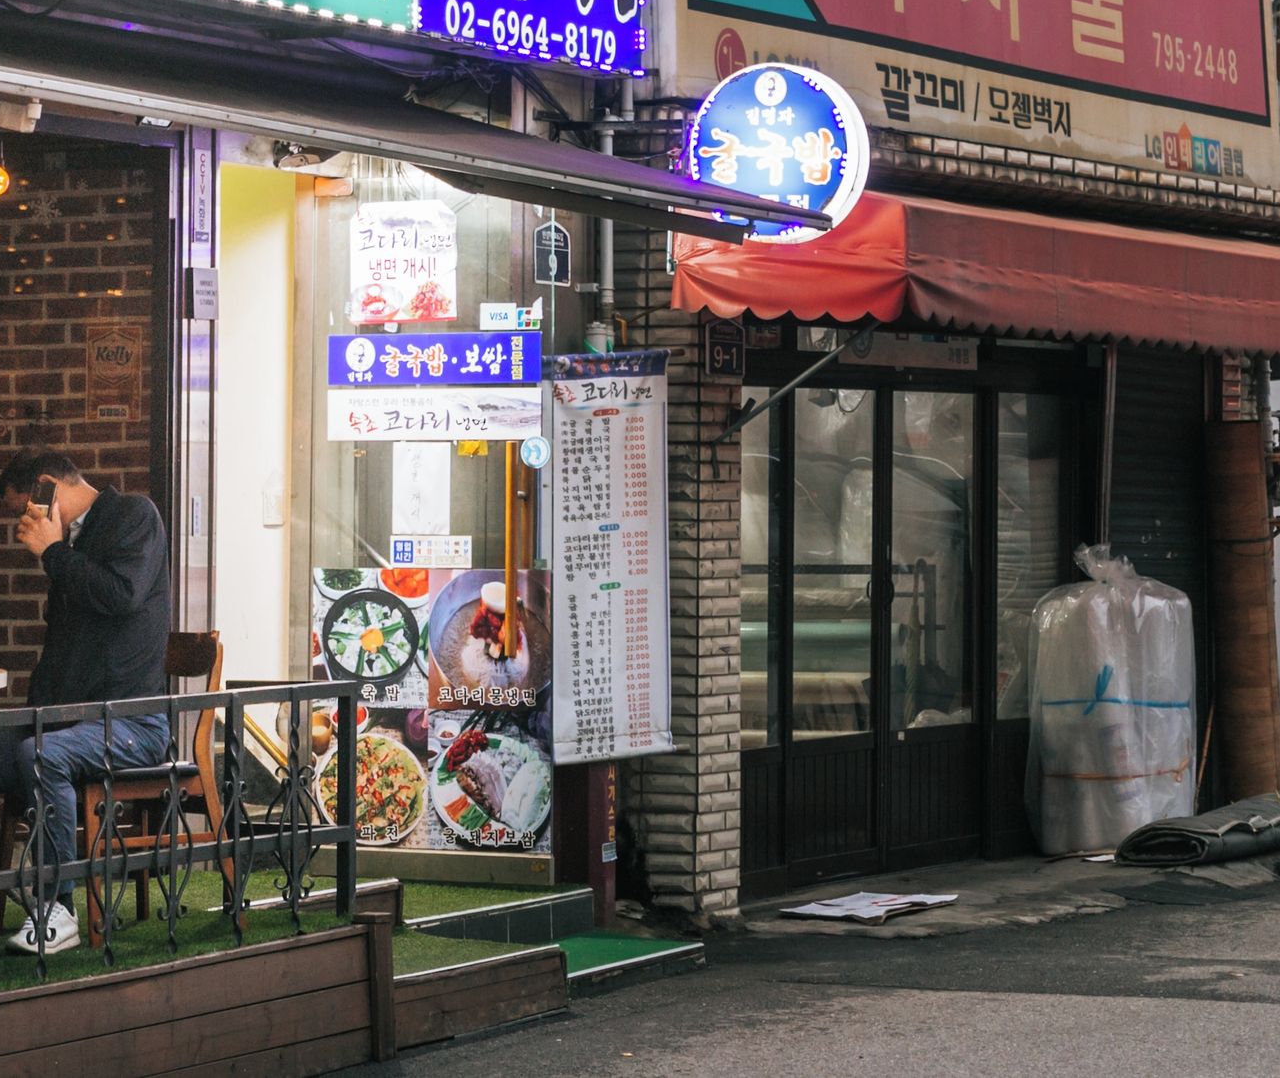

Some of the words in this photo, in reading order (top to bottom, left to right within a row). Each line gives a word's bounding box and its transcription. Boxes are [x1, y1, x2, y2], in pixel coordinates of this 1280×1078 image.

[988, 84, 1072, 139] 모젤벽지
[699, 128, 842, 186] 굴국밥
[369, 257, 399, 282] 냉면
[490, 311, 509, 322] VISA
[95, 345, 134, 367] Kelly
[581, 379, 628, 403] 코다리
[348, 410, 378, 433] 속초
[382, 408, 452, 432] 코다리
[395, 552, 412, 562] 시간
[360, 824, 400, 843] 파전
